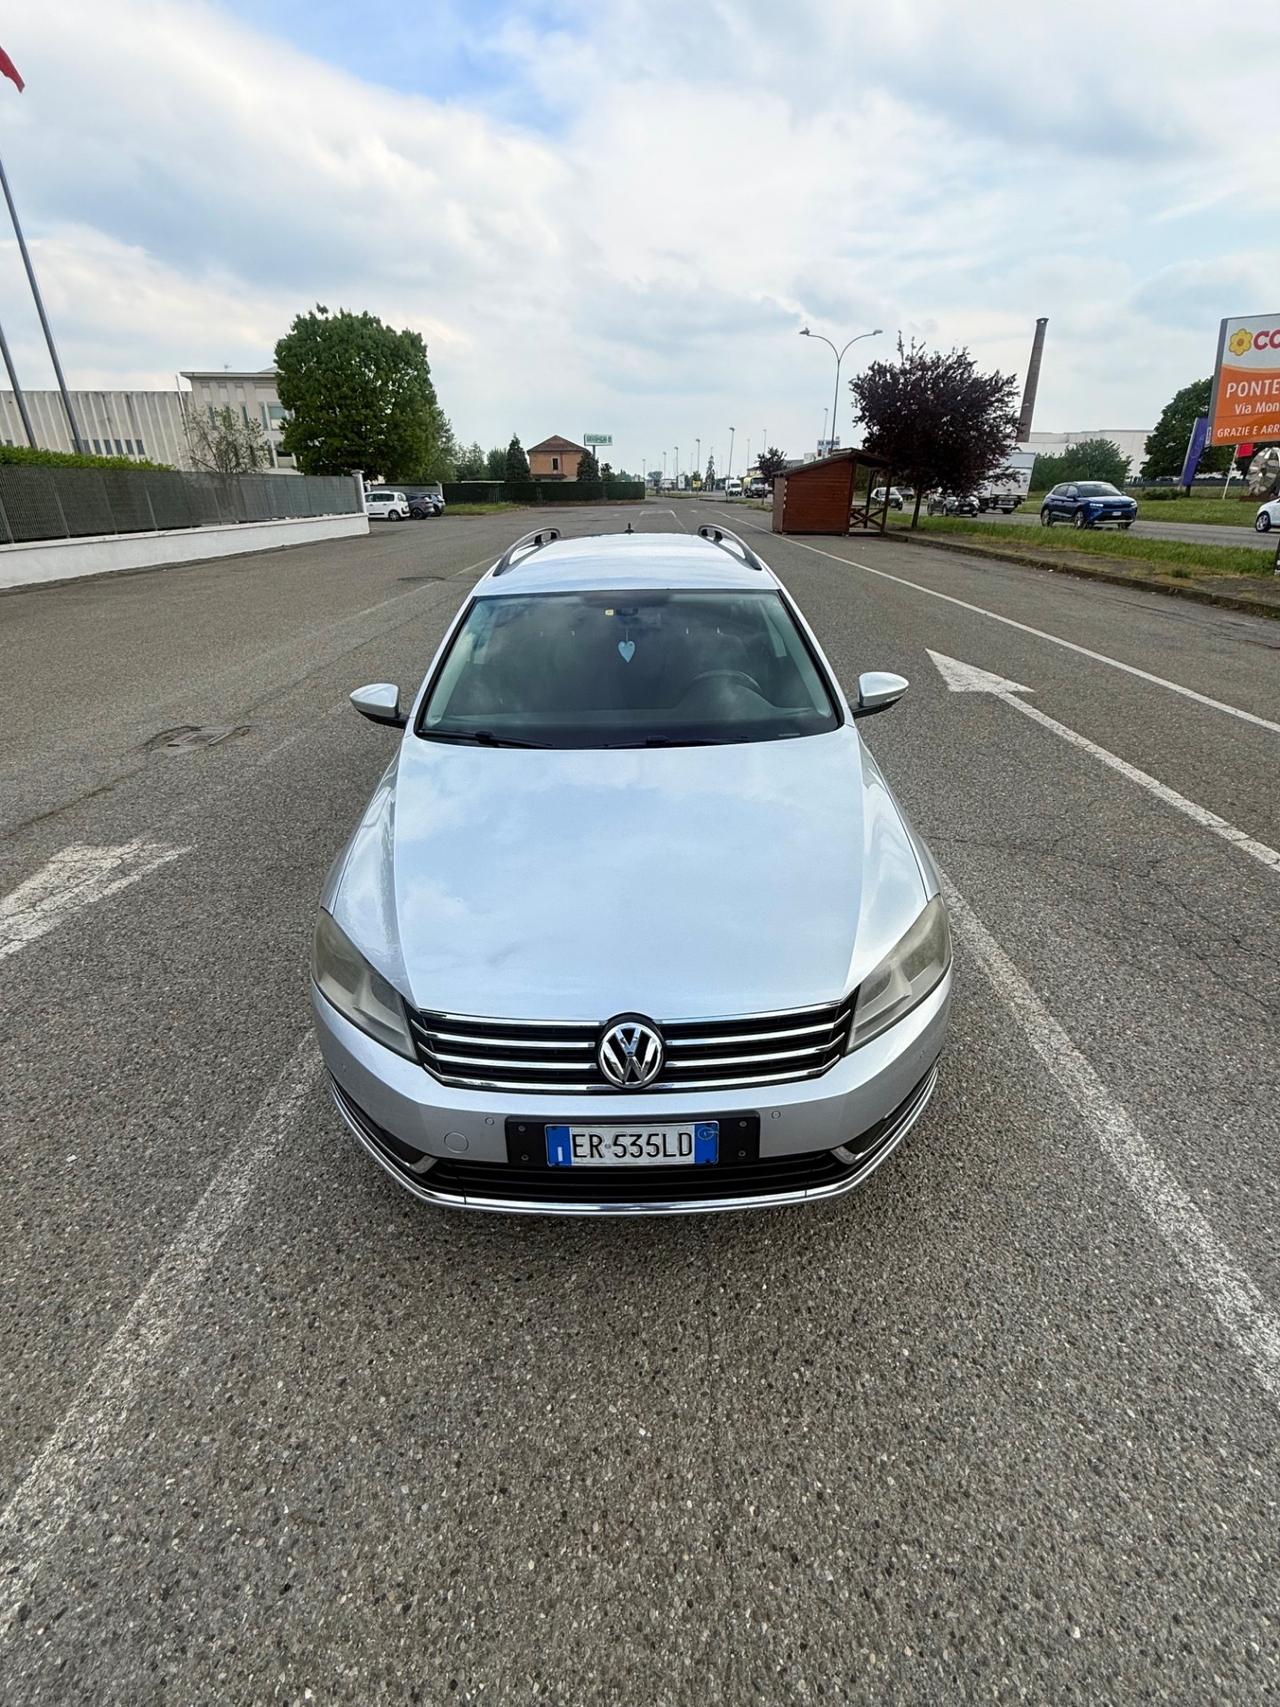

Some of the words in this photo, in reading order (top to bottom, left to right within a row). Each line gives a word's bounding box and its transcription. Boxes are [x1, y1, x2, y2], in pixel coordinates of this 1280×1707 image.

[1226, 379, 1280, 398] PONTE
[1235, 402, 1252, 415] Via
[1255, 401, 1280, 413] Mon
[1217, 426, 1250, 438] GRAZIE
[1252, 425, 1259, 435] E
